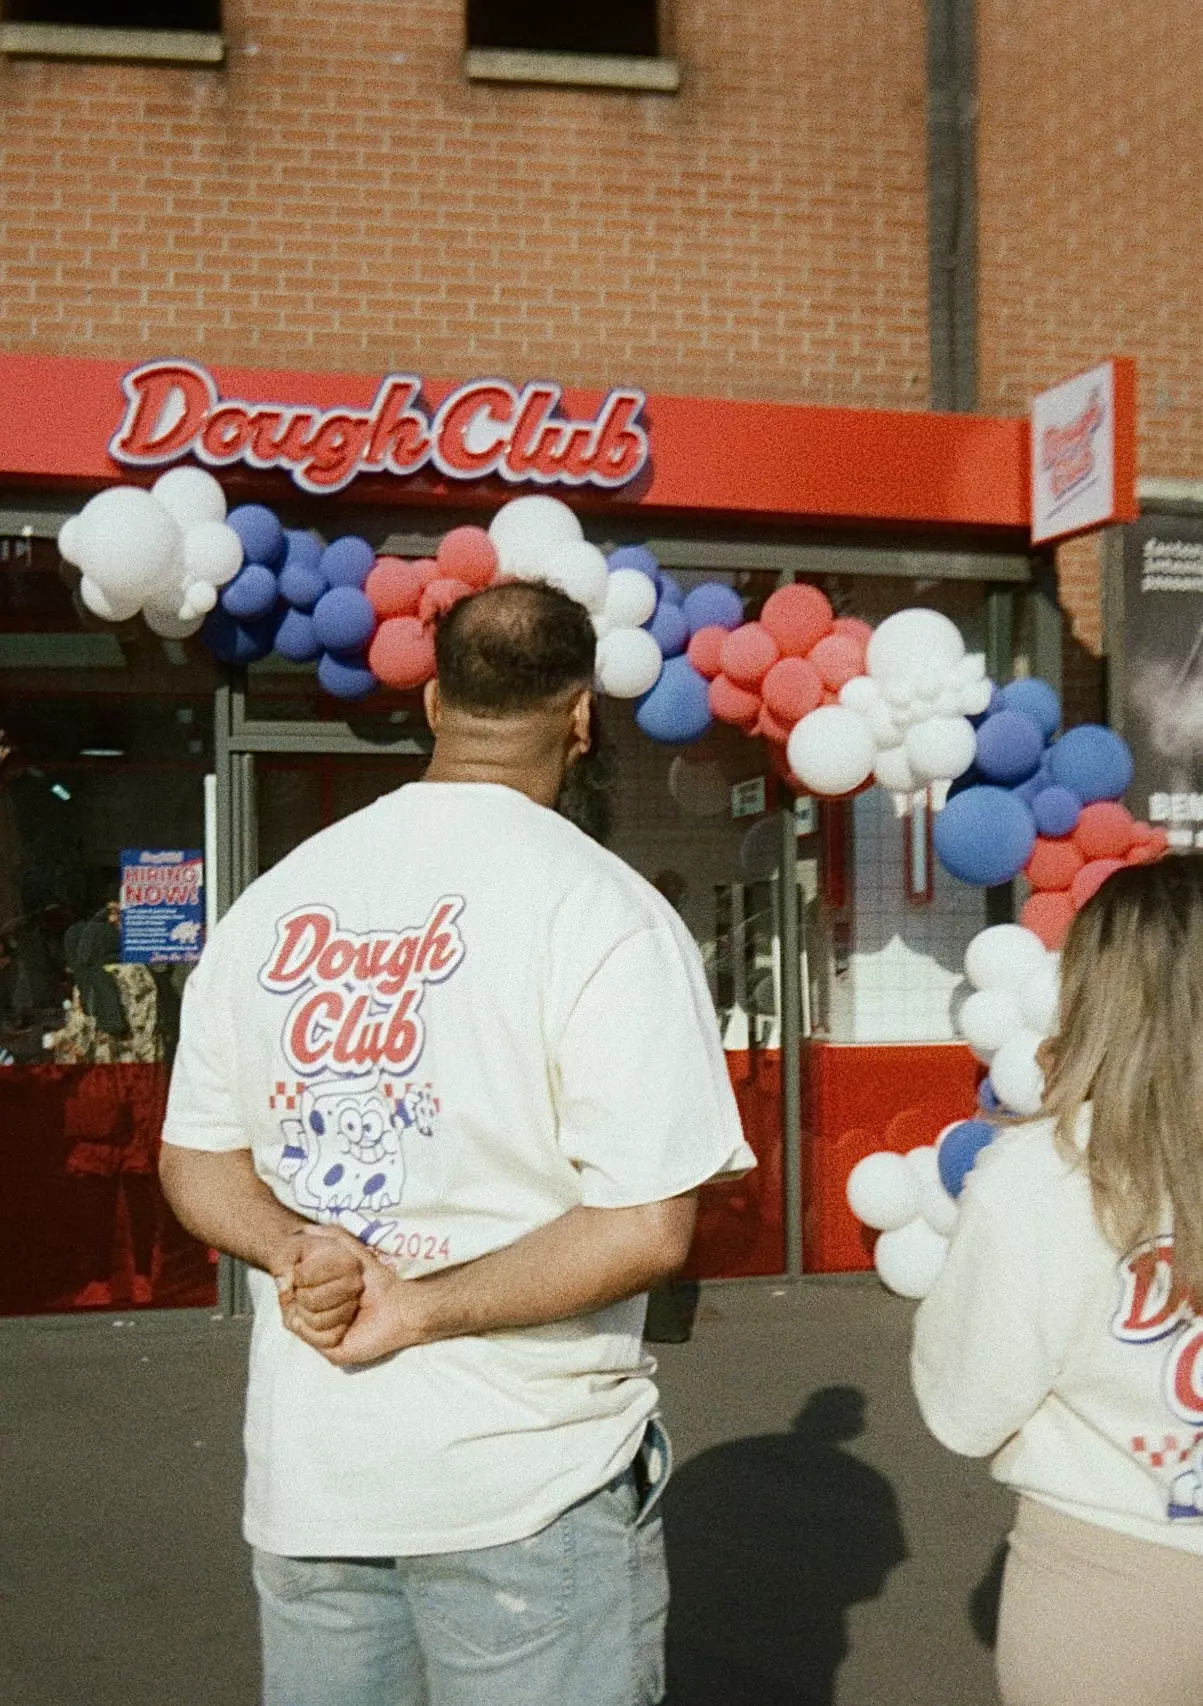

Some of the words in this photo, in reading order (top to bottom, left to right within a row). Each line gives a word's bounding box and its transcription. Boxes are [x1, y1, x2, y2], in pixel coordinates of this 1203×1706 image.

[115, 362, 431, 488] Dough
[436, 382, 645, 481] Club
[266, 902, 458, 996] Dough
[289, 988, 418, 1065] Club
[394, 1232, 451, 1261] 2024
